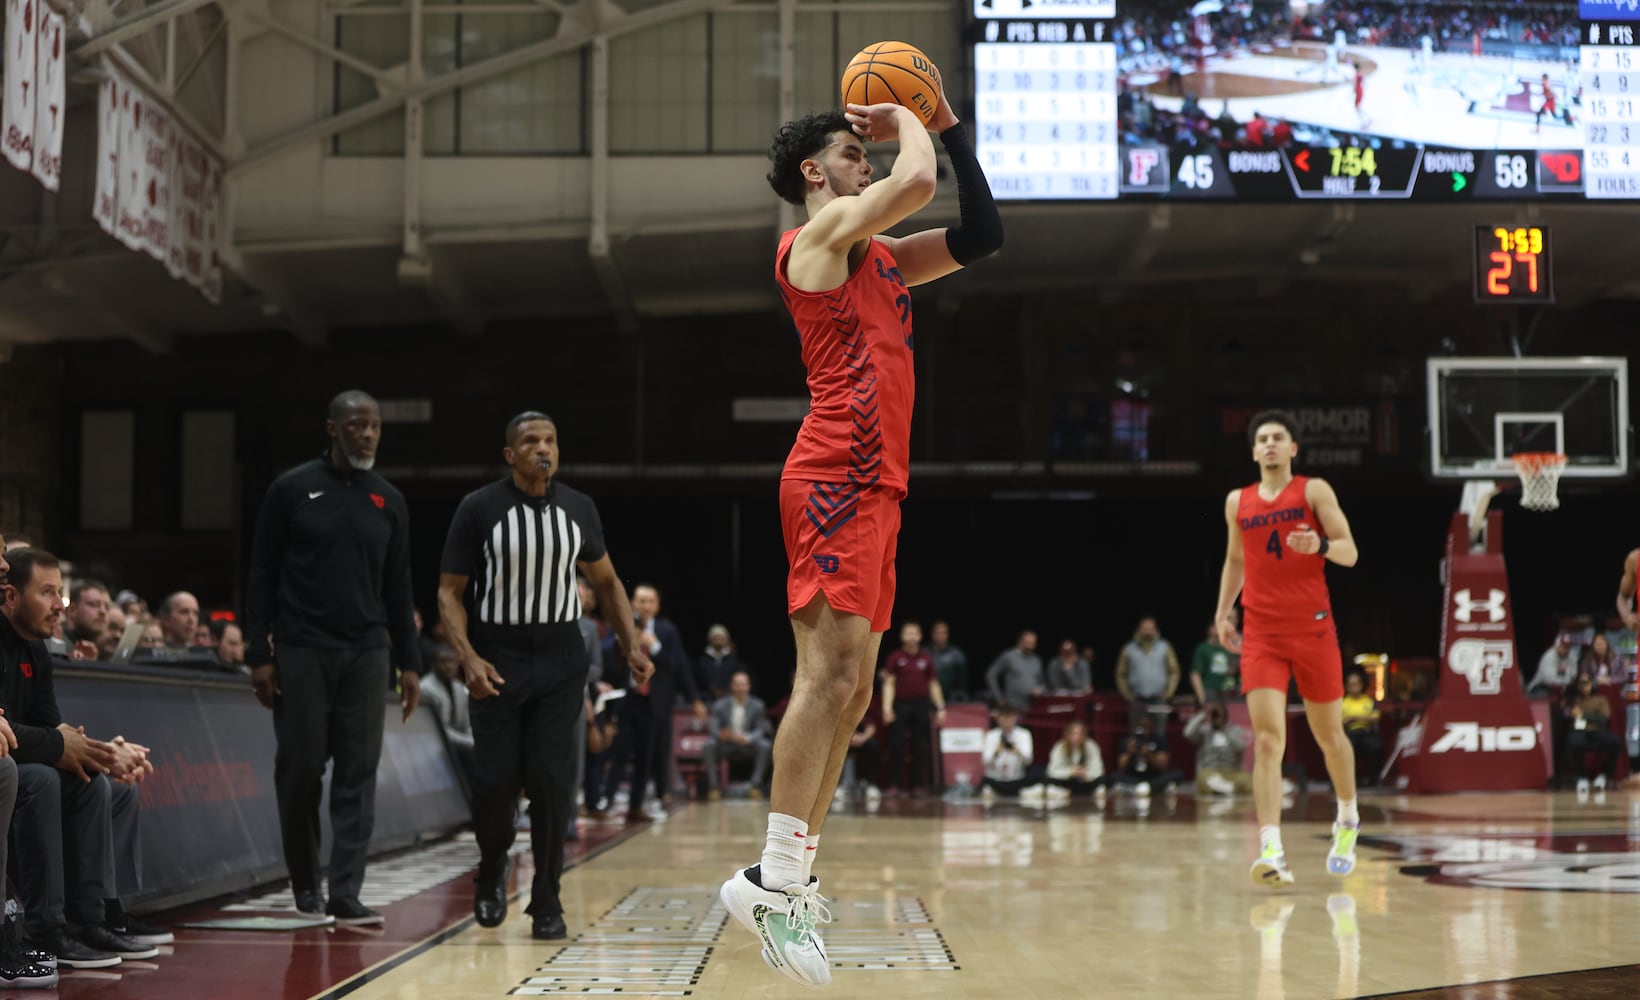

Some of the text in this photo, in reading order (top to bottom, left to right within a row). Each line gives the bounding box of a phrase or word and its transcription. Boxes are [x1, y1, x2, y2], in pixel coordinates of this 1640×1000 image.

[1073, 22, 1086, 42] A
[1094, 22, 1106, 42] F
[1589, 22, 1633, 45] # PTS
[1616, 51, 1631, 69] 15
[1592, 75, 1628, 92] 4 9
[1591, 100, 1632, 117] 15 21
[1590, 126, 1630, 143] 22 3
[1229, 151, 1282, 174] BONUS
[1328, 147, 1377, 177] 7:54
[1424, 151, 1476, 174] BONUS
[1622, 151, 1630, 167] 4
[1177, 155, 1214, 190] 45
[1494, 155, 1529, 189] 58
[1368, 176, 1381, 195] 2
[1494, 227, 1543, 254] 7:53
[1487, 251, 1538, 295] 27
[1240, 507, 1305, 531] DAYTON
[1266, 529, 1283, 560] 4
